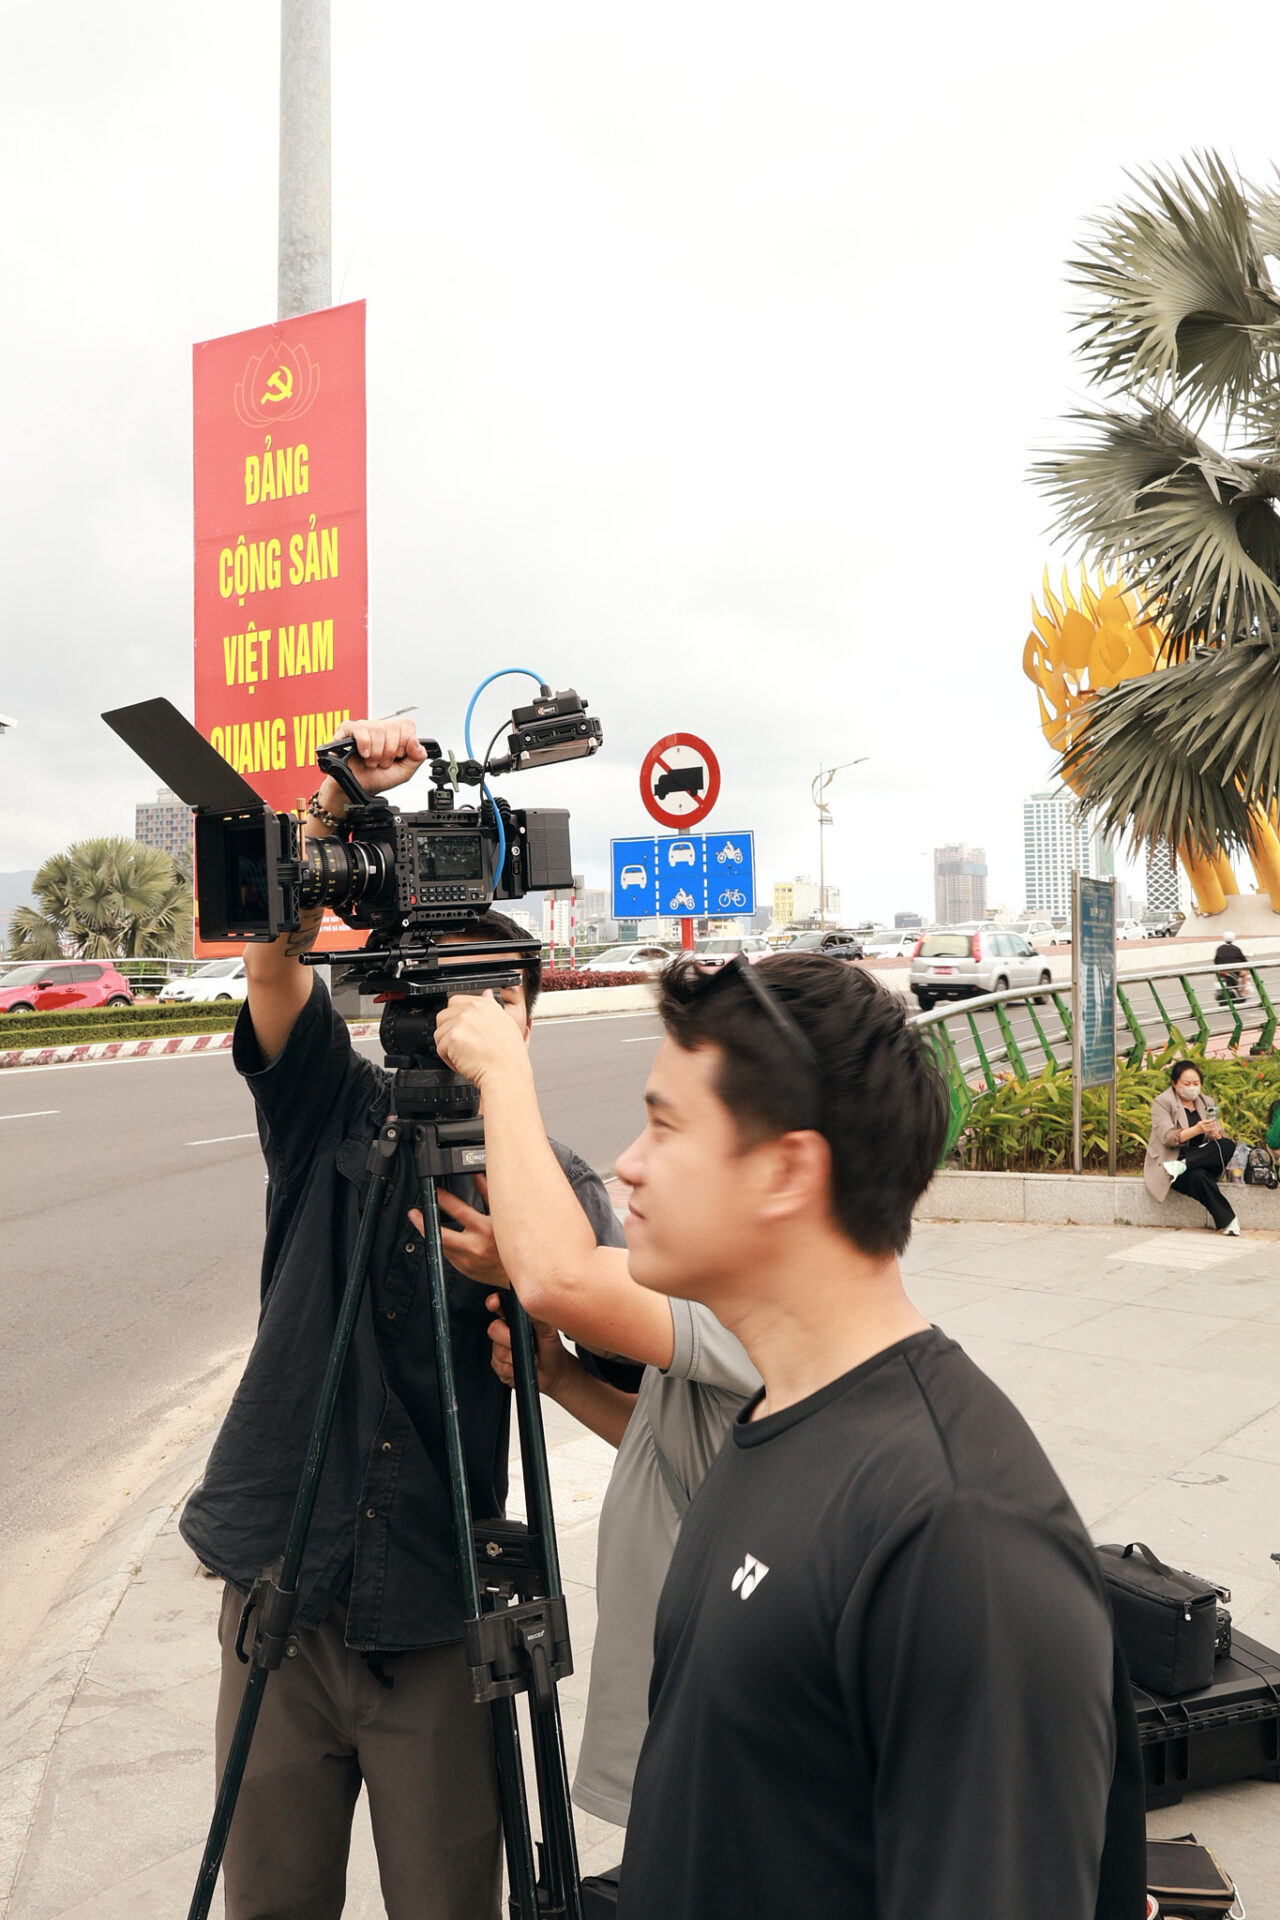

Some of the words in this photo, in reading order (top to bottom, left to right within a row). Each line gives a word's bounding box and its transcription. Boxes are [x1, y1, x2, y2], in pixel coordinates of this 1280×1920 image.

[245, 434, 309, 506] ĐẢNG
[218, 534, 281, 607] CỘNG
[289, 513, 339, 586] SẢN
[223, 621, 271, 694] VIỆT
[278, 618, 335, 679] NAM
[210, 718, 286, 775] QUANG
